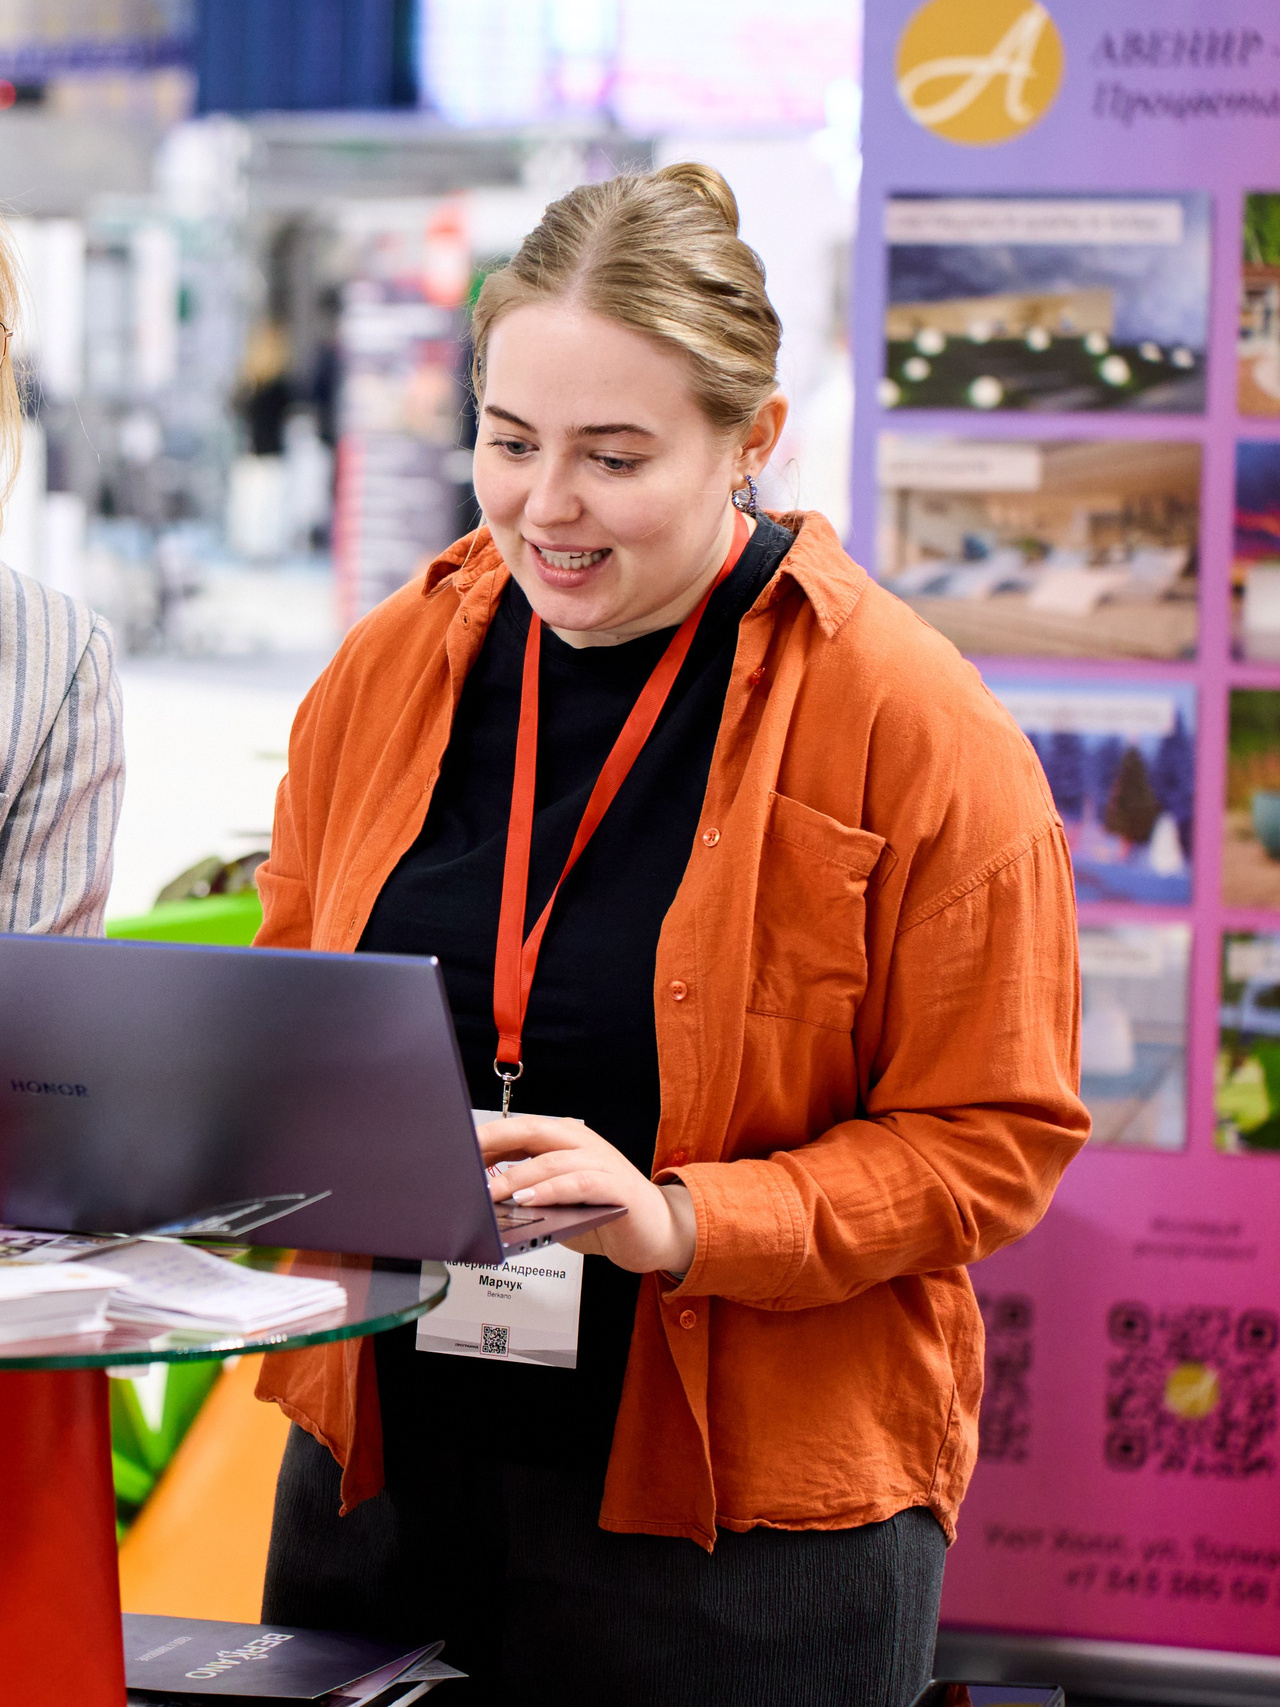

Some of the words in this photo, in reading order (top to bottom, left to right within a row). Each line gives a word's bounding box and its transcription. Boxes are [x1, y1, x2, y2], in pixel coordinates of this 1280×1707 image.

[10, 1080, 90, 1099] HONOR
[502, 1261, 567, 1279] Андреевна
[478, 1274, 523, 1291] Марчук
[486, 1290, 512, 1300] Berkano
[184, 1632, 296, 1679] BERKANO
